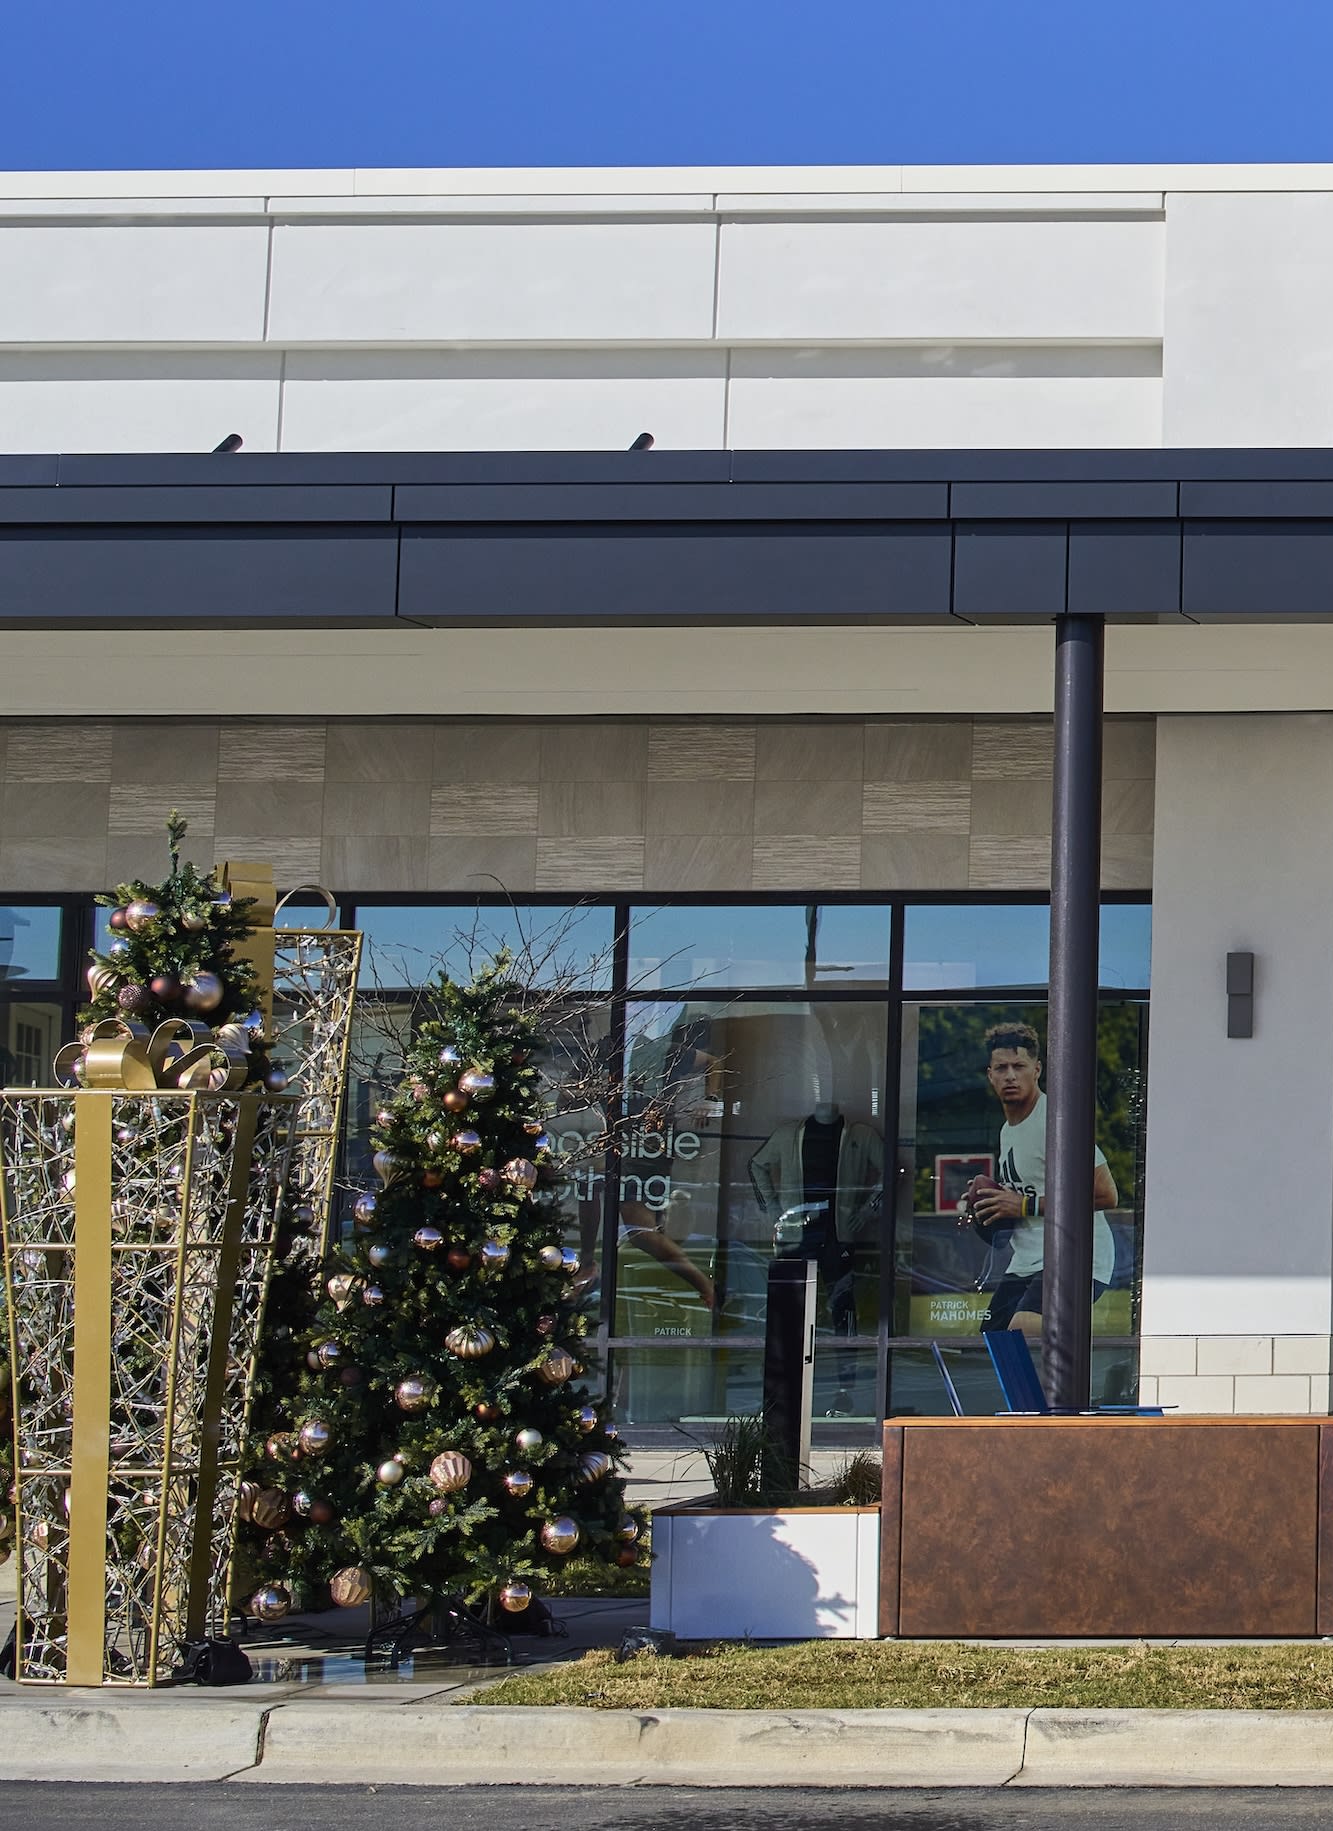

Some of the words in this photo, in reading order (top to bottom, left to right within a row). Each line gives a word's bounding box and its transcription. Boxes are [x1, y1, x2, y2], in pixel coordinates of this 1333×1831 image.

[930, 1301, 969, 1309] PATRICK
[930, 1310, 992, 1321] MAHOMES
[654, 1327, 692, 1336] PATRICK
